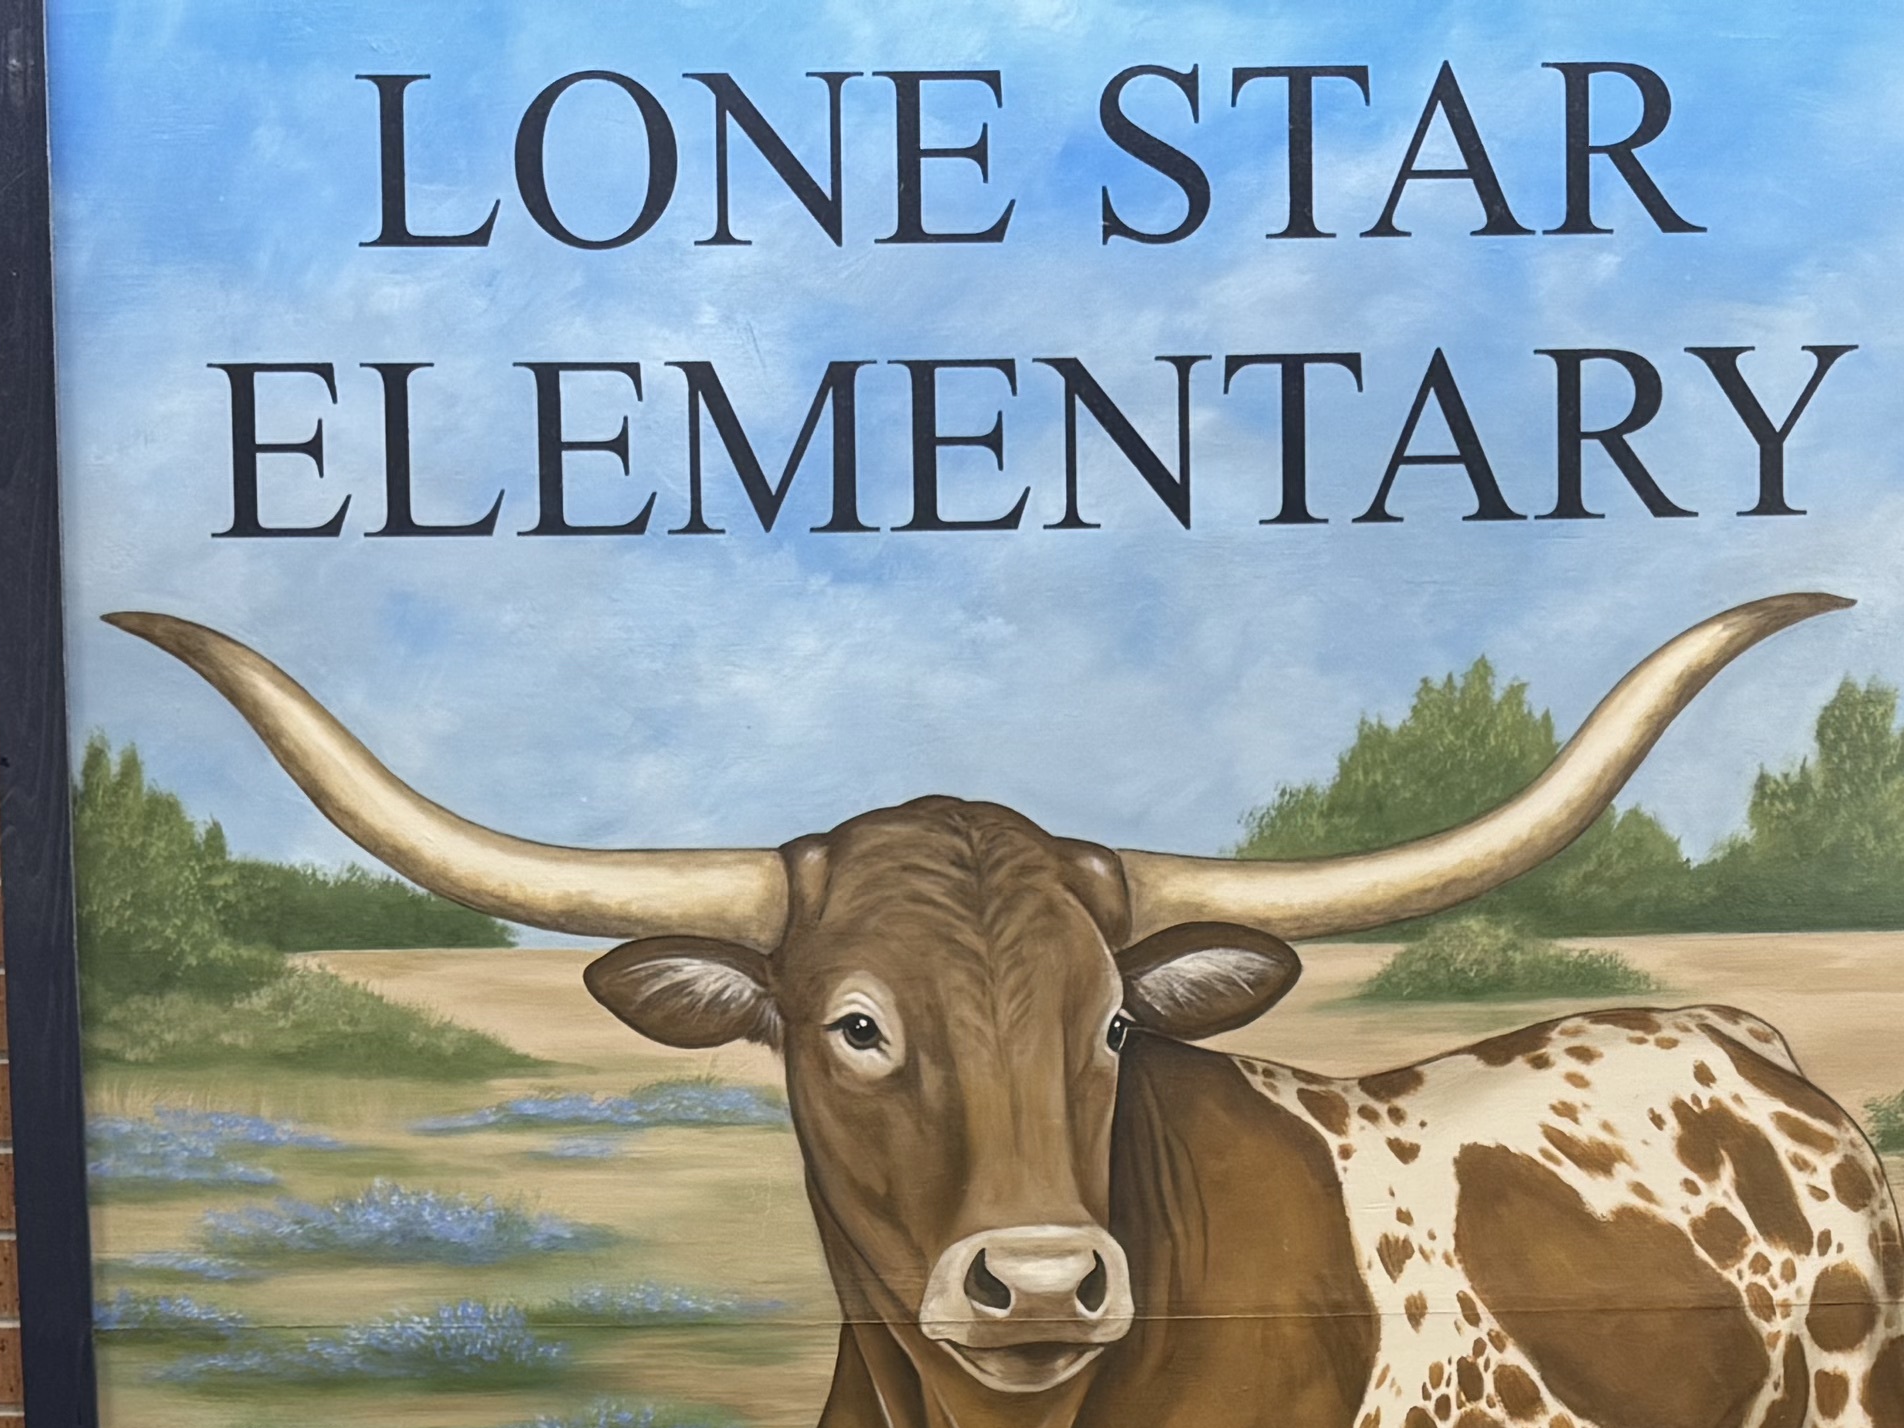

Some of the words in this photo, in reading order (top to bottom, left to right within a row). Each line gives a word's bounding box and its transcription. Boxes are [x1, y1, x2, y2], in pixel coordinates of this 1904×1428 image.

[355, 71, 1014, 249] LONE
[1101, 61, 1706, 244] STAR
[207, 346, 1858, 537] ELEMENTARY
